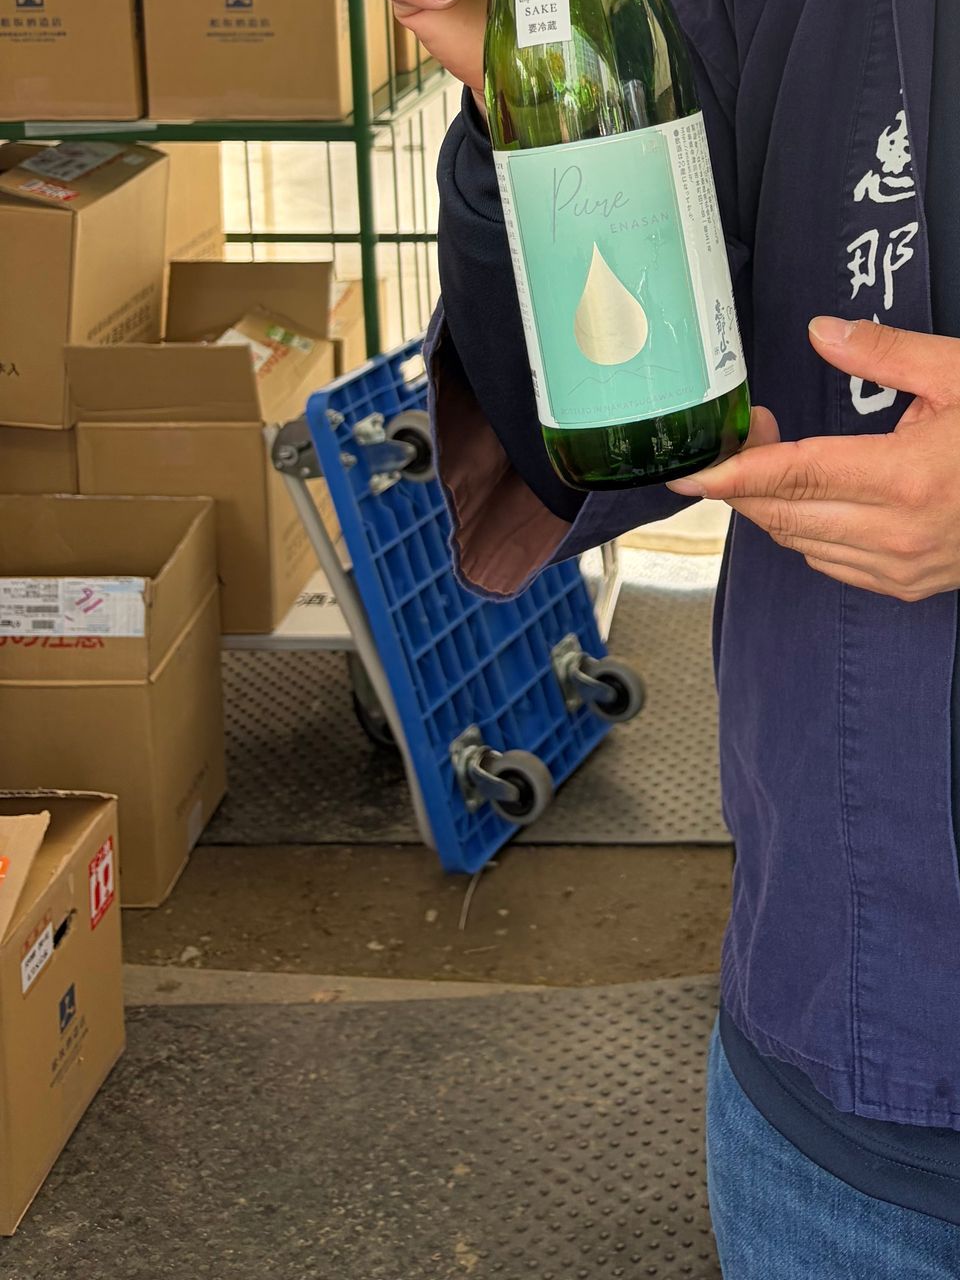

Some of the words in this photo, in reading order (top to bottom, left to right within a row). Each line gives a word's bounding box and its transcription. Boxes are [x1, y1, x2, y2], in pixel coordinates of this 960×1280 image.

[524, 3, 558, 17] SAKE
[528, 20, 558, 34] 要冷蔵
[552, 164, 631, 244] Pure
[610, 211, 670, 234] ENASAN
